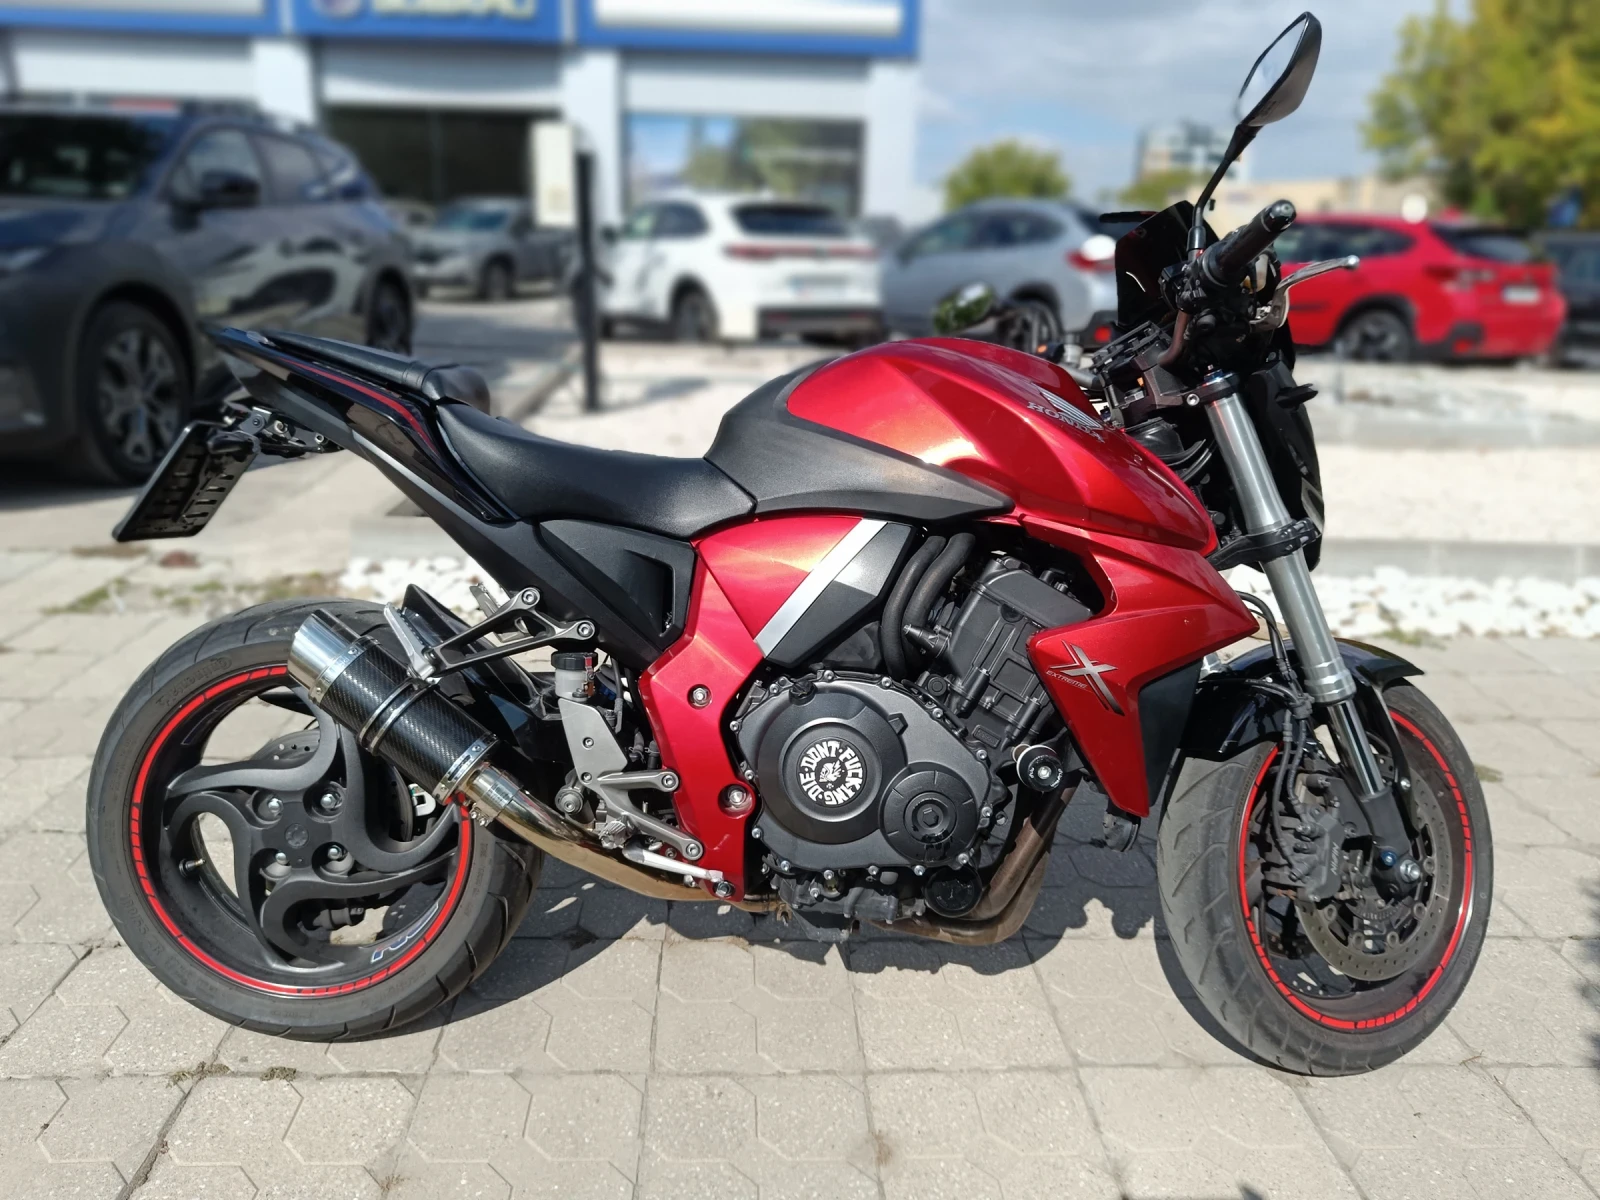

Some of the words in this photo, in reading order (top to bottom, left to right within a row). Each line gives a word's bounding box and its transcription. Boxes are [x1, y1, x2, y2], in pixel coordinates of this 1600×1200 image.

[1027, 401, 1106, 443] HONDA
[1046, 670, 1088, 689] EXTREME
[800, 740, 840, 771] DONT
[799, 772, 825, 802] DIE
[823, 746, 863, 805] FUCKING
